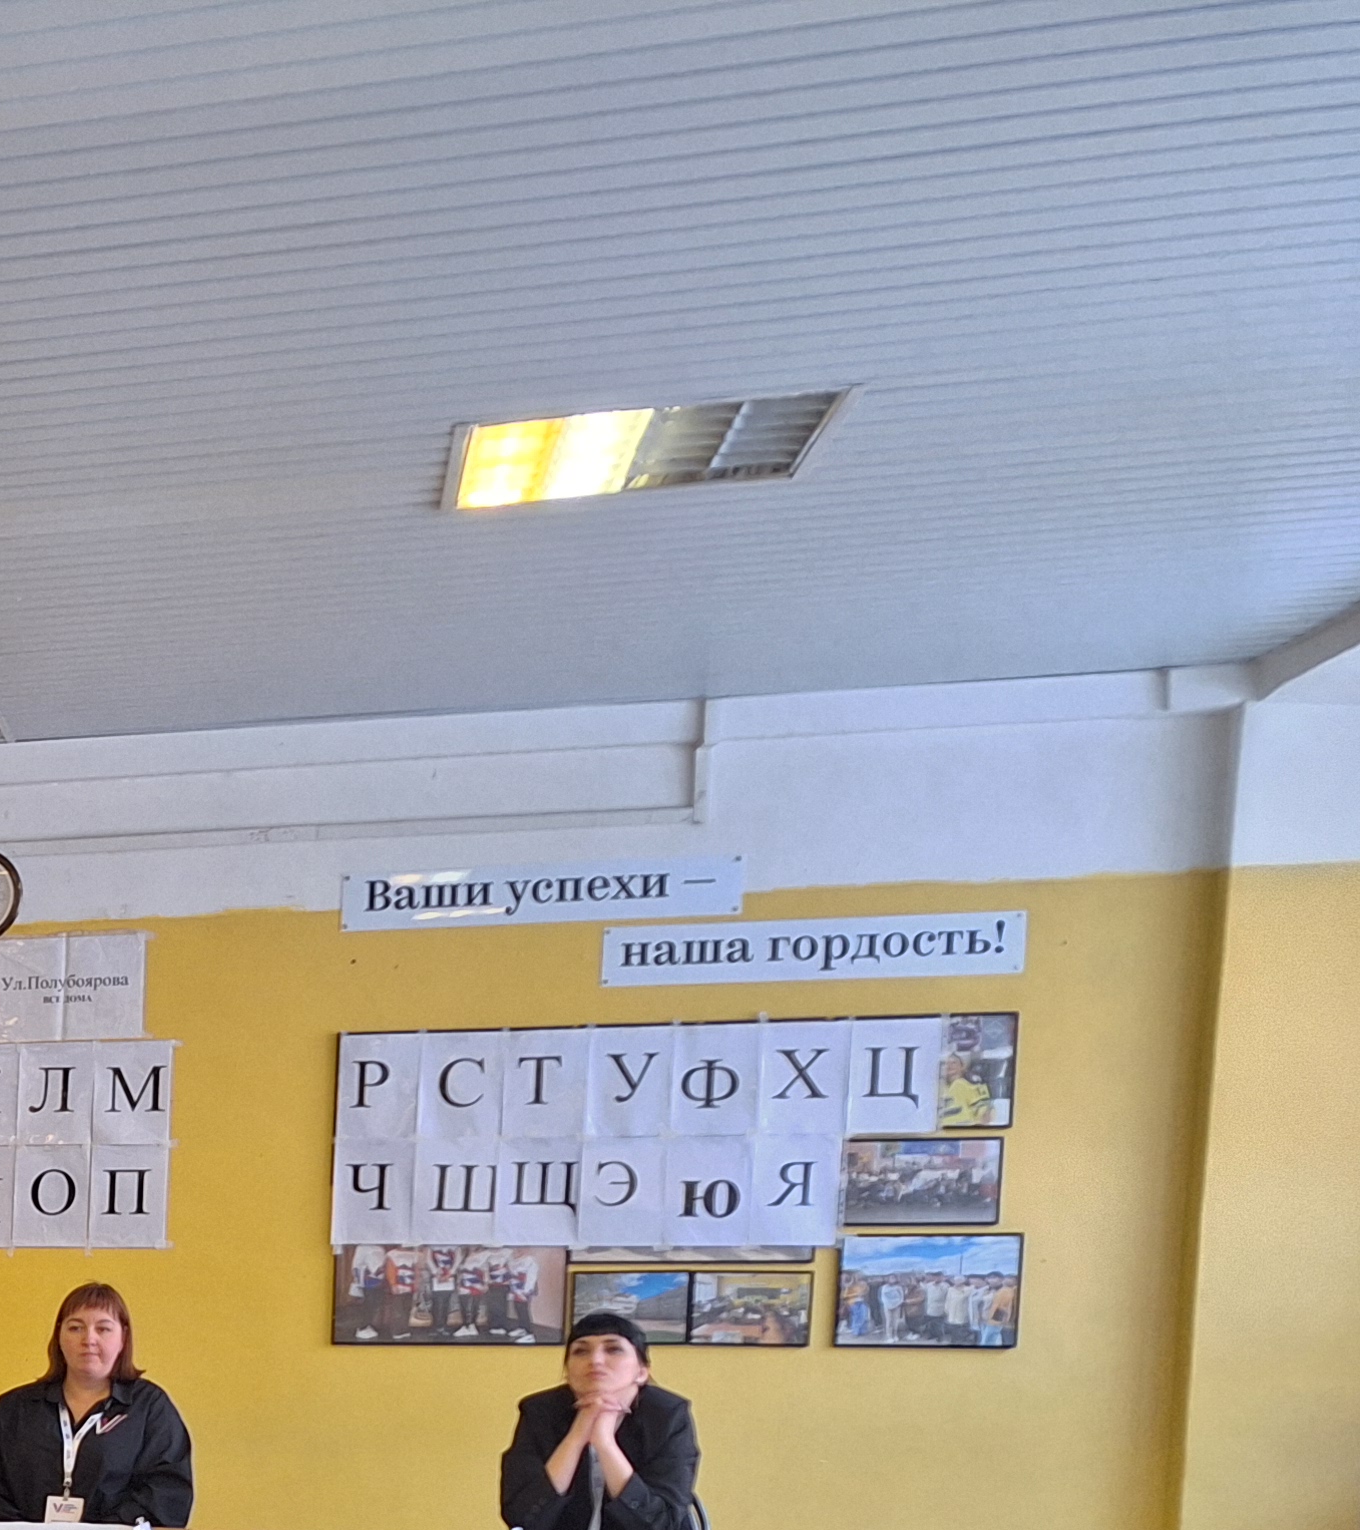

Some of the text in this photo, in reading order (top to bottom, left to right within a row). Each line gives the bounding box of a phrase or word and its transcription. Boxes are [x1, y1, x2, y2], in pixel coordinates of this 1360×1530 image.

[366, 880, 492, 911] Ваши
[505, 874, 668, 915] успехи
[622, 920, 1005, 971] наша гордость!
[29, 1067, 74, 1112] Л
[110, 1066, 164, 1112] М
[353, 1047, 918, 1108] Р С Т У Ф Х Ц
[105, 1170, 147, 1214] П
[350, 1164, 389, 1210] Ч
[431, 1165, 496, 1212] Ш
[512, 1162, 578, 1217] Щ
[597, 1161, 637, 1206] Э
[768, 1162, 814, 1206] Я
